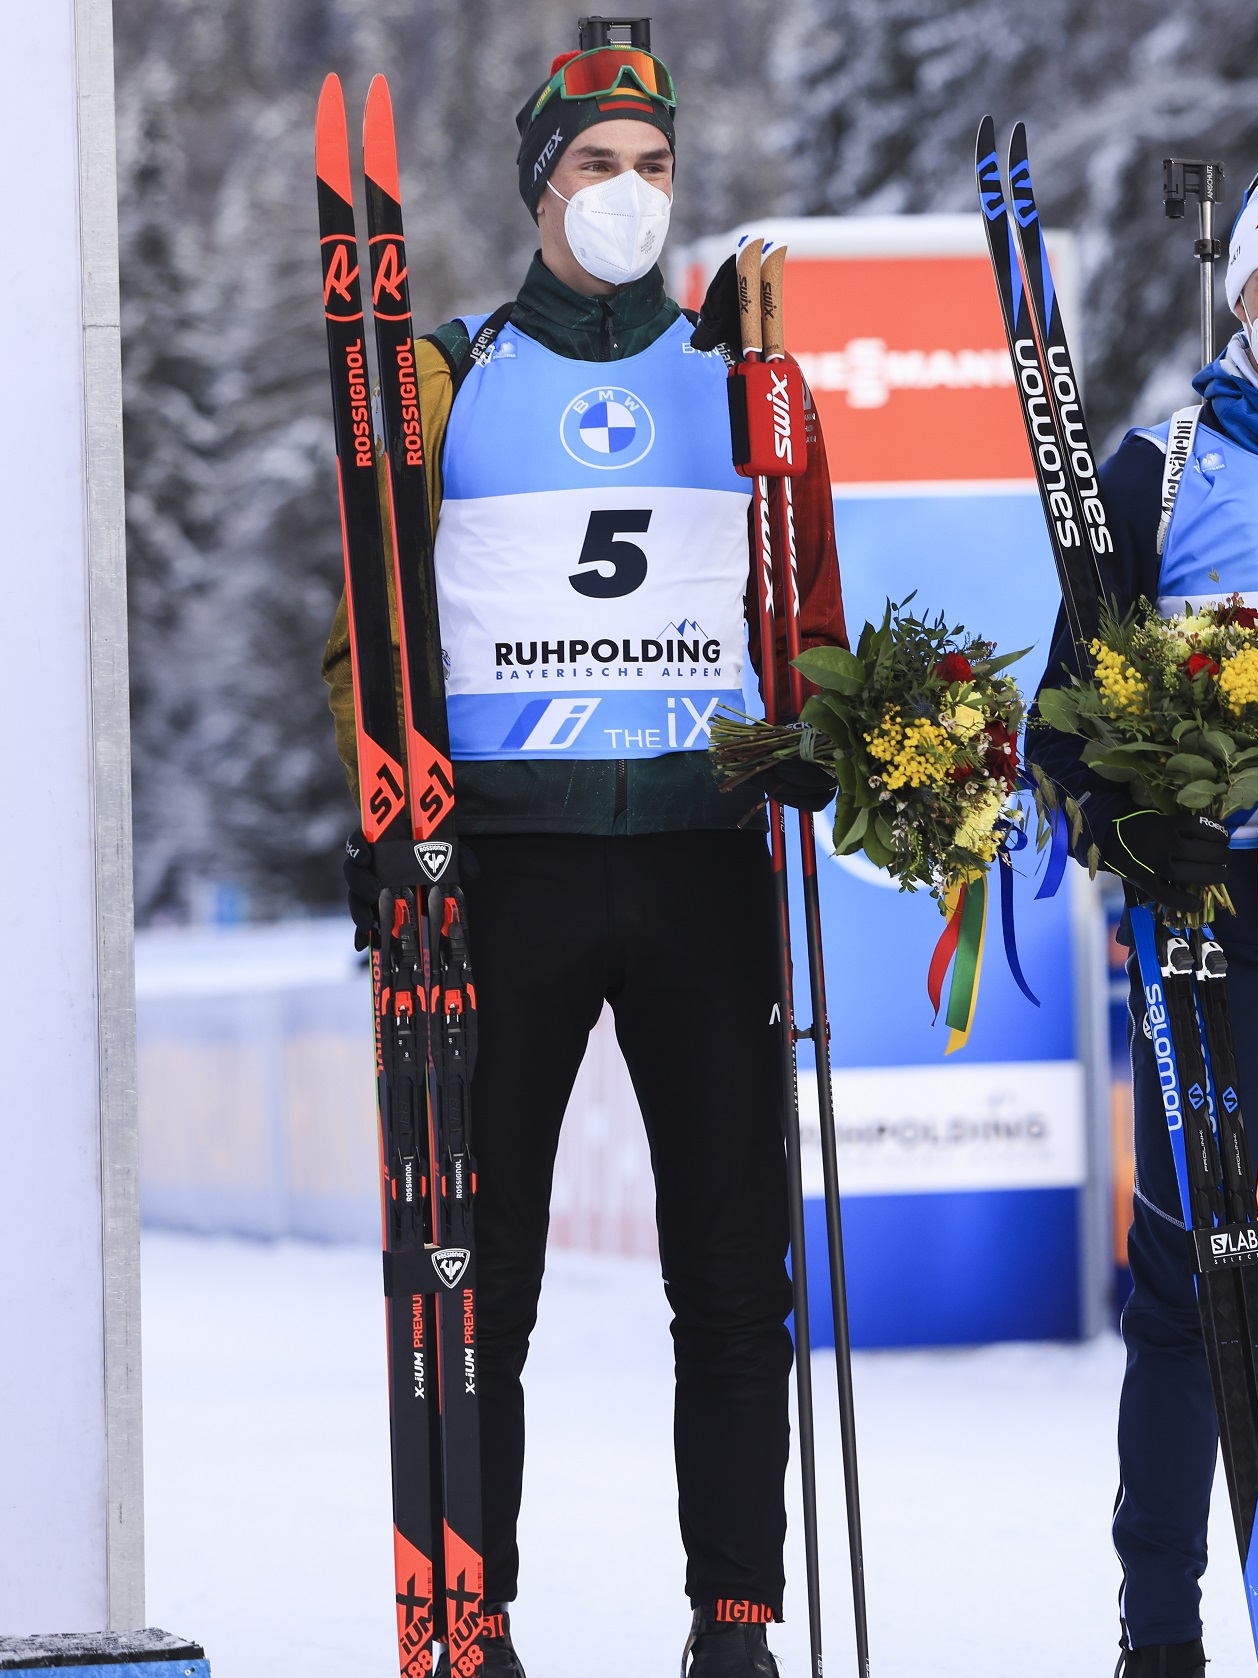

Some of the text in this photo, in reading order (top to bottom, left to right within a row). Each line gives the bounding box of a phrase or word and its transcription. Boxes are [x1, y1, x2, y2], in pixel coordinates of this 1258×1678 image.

[567, 508, 653, 599] 5
[494, 638, 722, 667] RUHPOLDING
[495, 666, 722, 681] BAYERISCHE ALPEN
[604, 729, 661, 749] THE
[370, 762, 404, 826] S1
[420, 760, 454, 824] S1
[1145, 983, 1183, 1132] salomon
[405, 1162, 414, 1203] ROSSIGNOL
[455, 1158, 463, 1199] ROSSIGNOL
